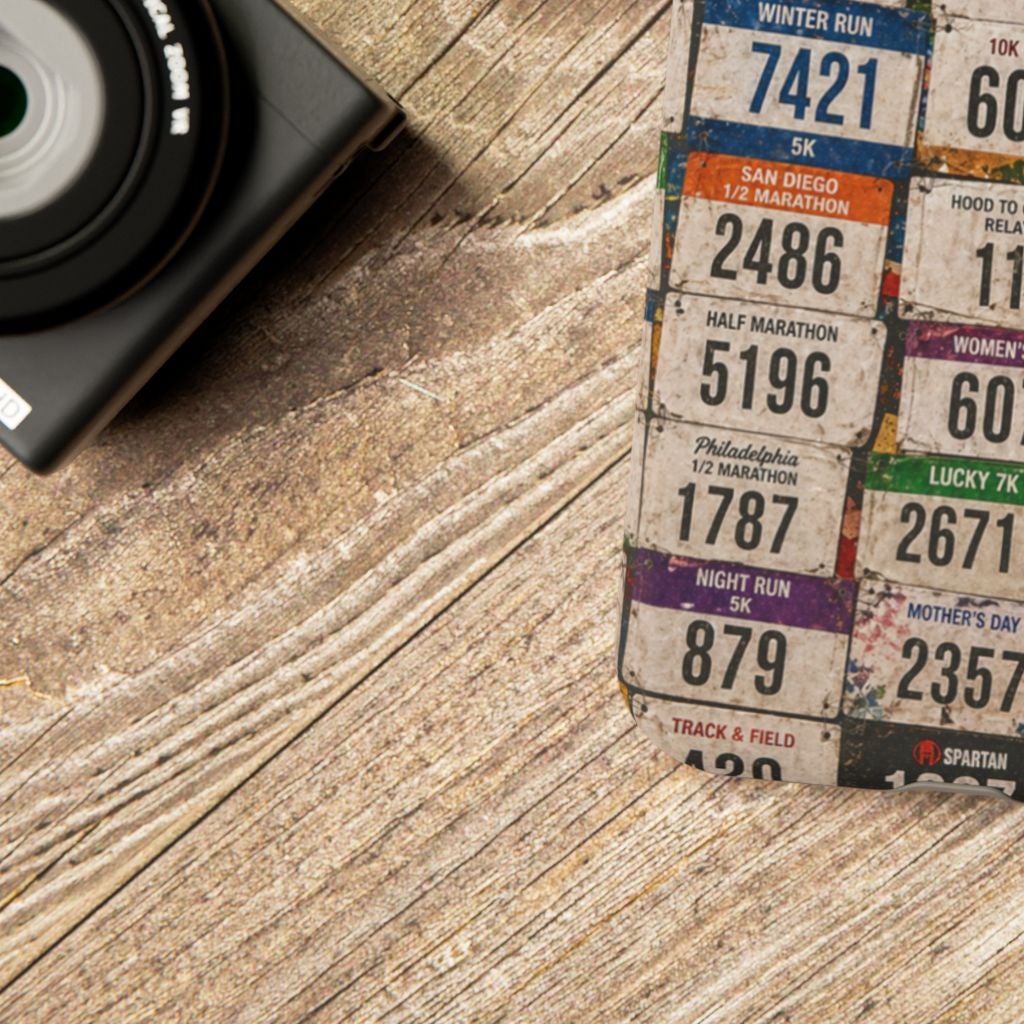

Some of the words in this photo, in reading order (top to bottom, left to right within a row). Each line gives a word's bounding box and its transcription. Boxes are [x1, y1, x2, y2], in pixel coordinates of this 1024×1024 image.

[757, 2, 829, 31] WINTER
[833, 12, 874, 37] RUN
[988, 38, 1019, 58] 10K
[749, 41, 878, 130] 7421
[791, 136, 817, 158] 5K
[741, 165, 778, 187] SAN
[781, 174, 839, 195] DIEGO
[723, 183, 749, 202] 1/2
[754, 187, 850, 216] MARATHON
[951, 194, 994, 214] HOOD
[999, 199, 1019, 216] TO
[710, 212, 845, 295] 2486
[976, 242, 1024, 310] 11
[706, 309, 747, 331] HALF
[750, 315, 839, 343] MARATHON
[700, 339, 832, 419] 5196
[694, 435, 800, 470] Philadelphia
[692, 459, 714, 475] 1/2
[717, 463, 799, 487] MARATHON
[929, 465, 990, 491] LUCKY
[995, 472, 1020, 494] 7K
[678, 481, 799, 554] 1787
[896, 502, 1015, 573] 2671
[696, 568, 751, 592] NIGHT
[754, 578, 792, 599] RUN
[729, 596, 753, 614] 5K
[906, 602, 986, 629] MOTHER'S
[989, 614, 1022, 634] DAY
[681, 619, 788, 696] 879
[672, 716, 726, 740] TRACK
[731, 726, 744, 743] &
[750, 728, 796, 749] FIELD
[942, 747, 1009, 770] SPARTAN
